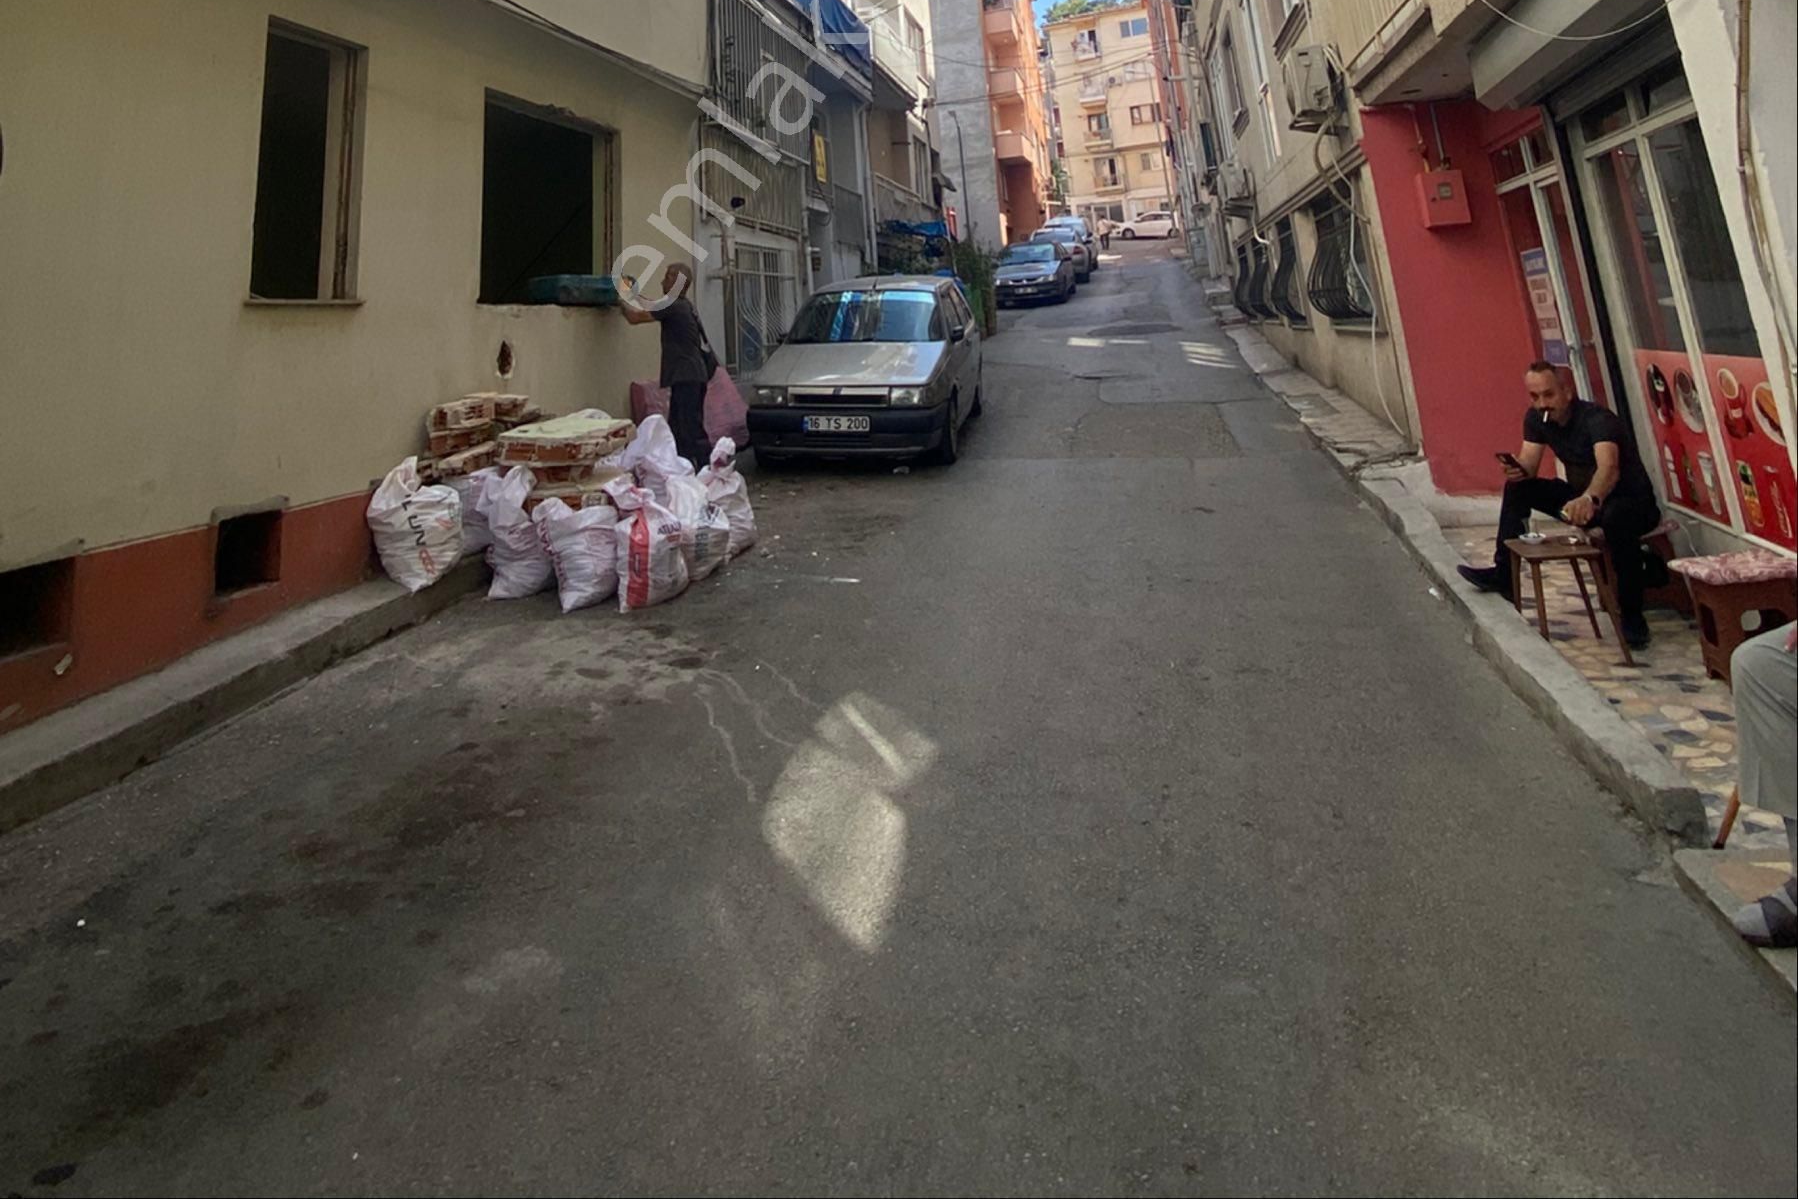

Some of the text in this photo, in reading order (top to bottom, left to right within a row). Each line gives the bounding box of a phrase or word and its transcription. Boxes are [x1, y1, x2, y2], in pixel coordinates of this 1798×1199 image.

[809, 417, 869, 430] 16 TS 200
